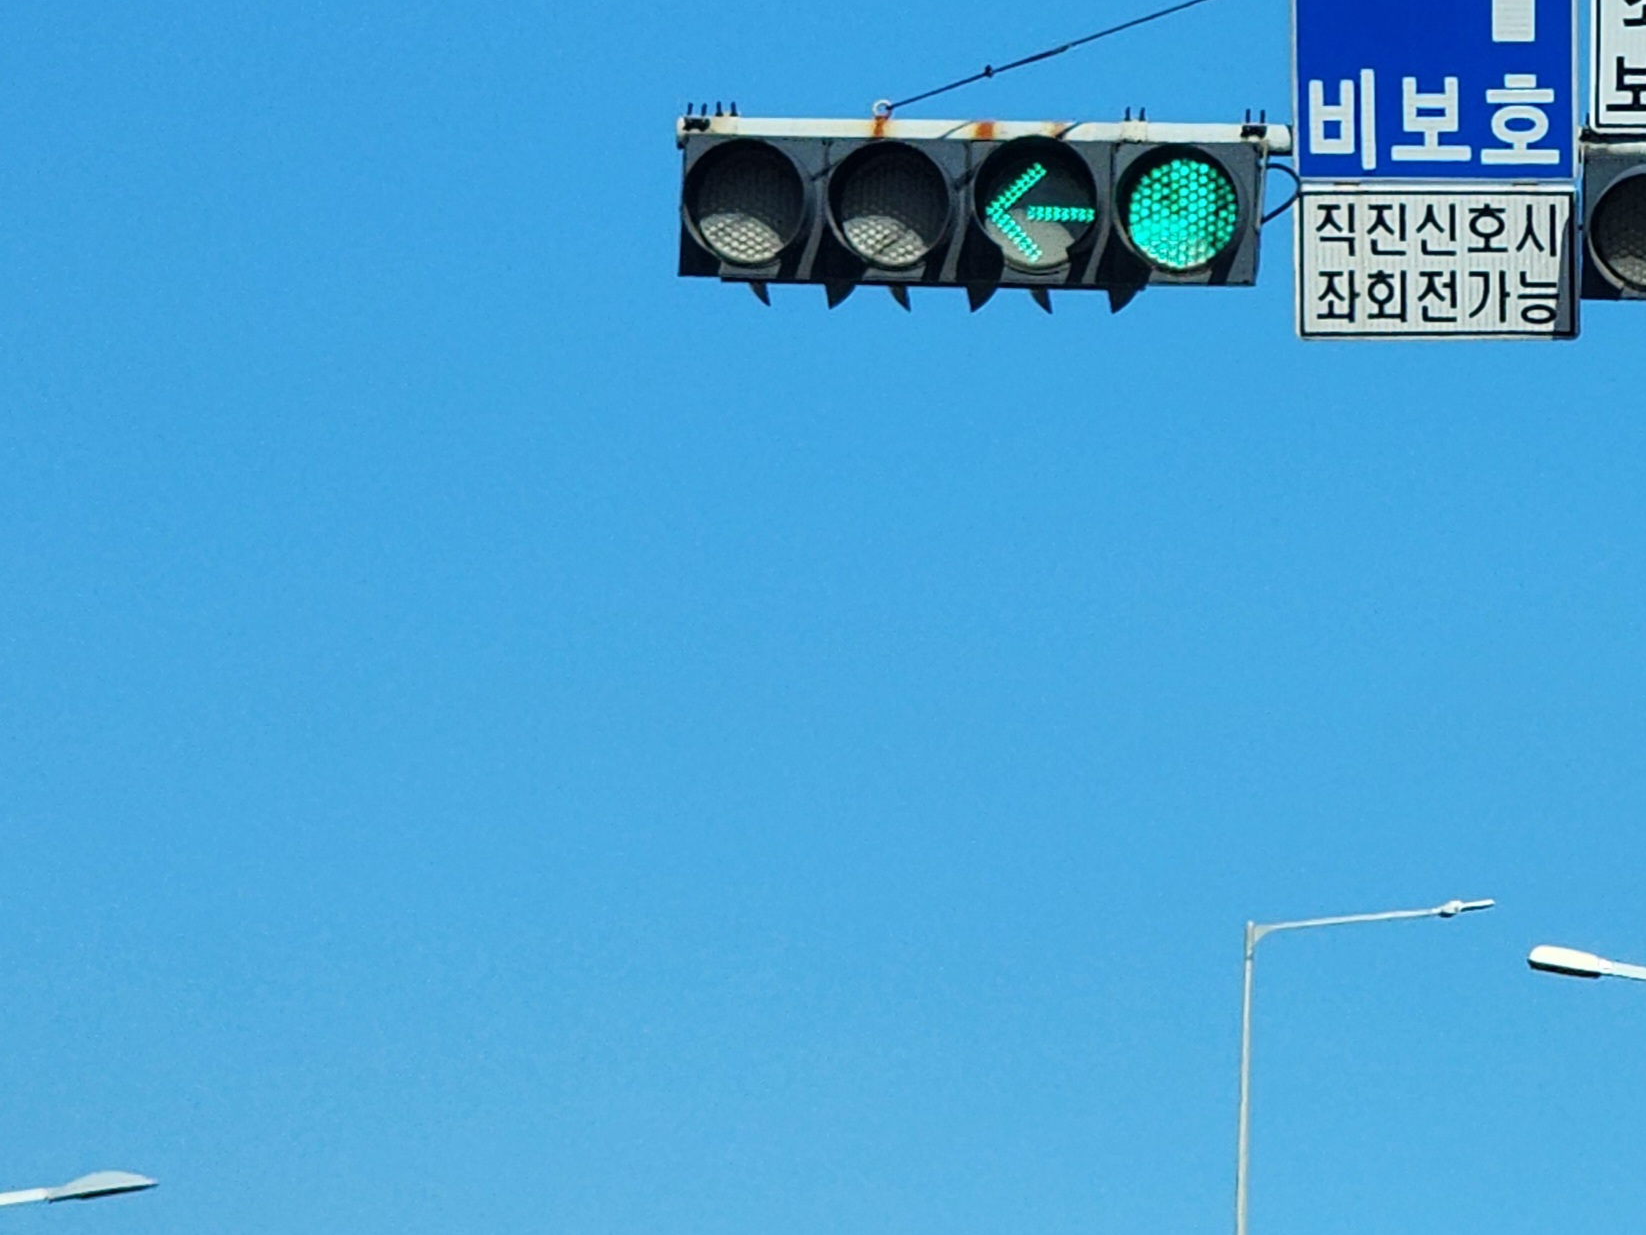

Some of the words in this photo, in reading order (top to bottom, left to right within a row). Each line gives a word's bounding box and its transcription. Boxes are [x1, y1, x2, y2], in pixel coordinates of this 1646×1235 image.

[1307, 68, 1561, 171] 비보호
[1315, 201, 1560, 259] 직진신호시
[1315, 268, 1560, 326] 좌회전가능
